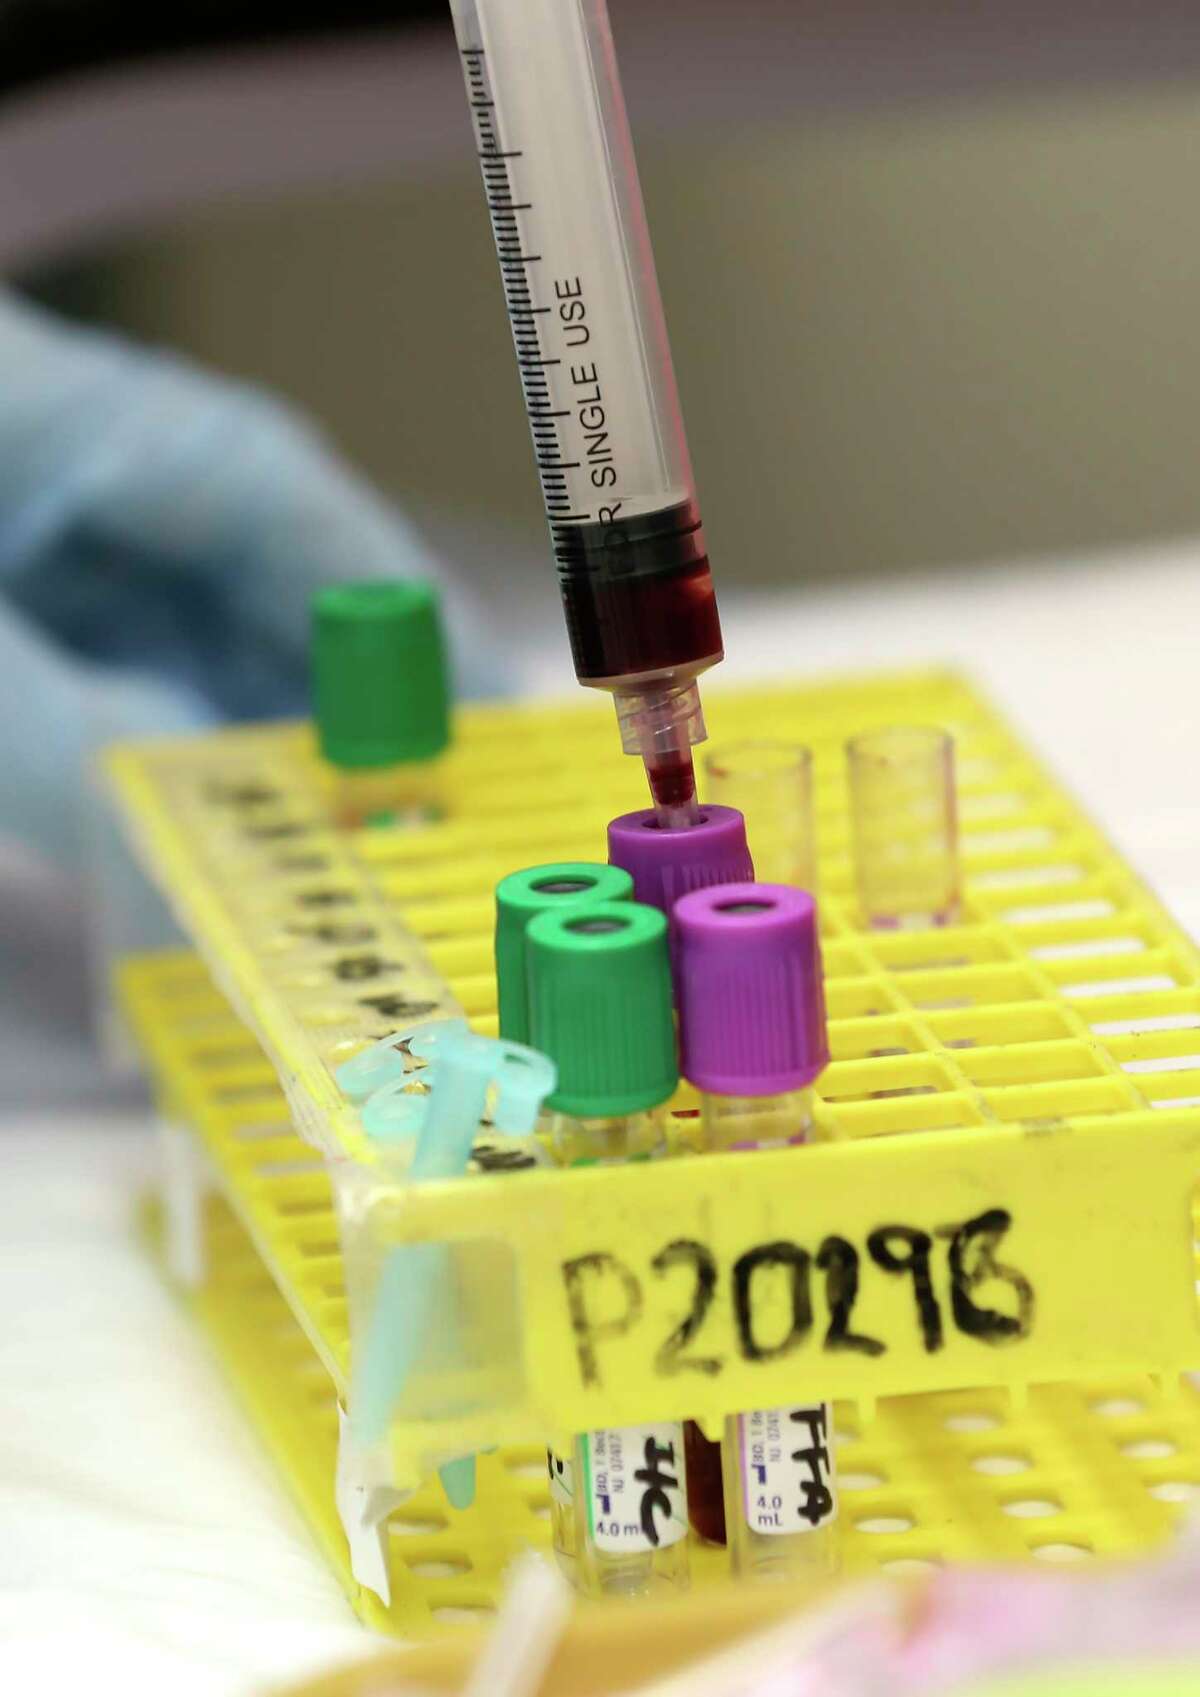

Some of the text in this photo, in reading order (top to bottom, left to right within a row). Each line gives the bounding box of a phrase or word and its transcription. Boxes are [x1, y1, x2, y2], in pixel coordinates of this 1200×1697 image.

[554, 276, 591, 347] USE
[570, 362, 618, 489] SINGLE
[757, 1495, 783, 1510] 4.0
[758, 1512, 783, 1526] mL
[596, 1520, 642, 1537] 4.0 m
